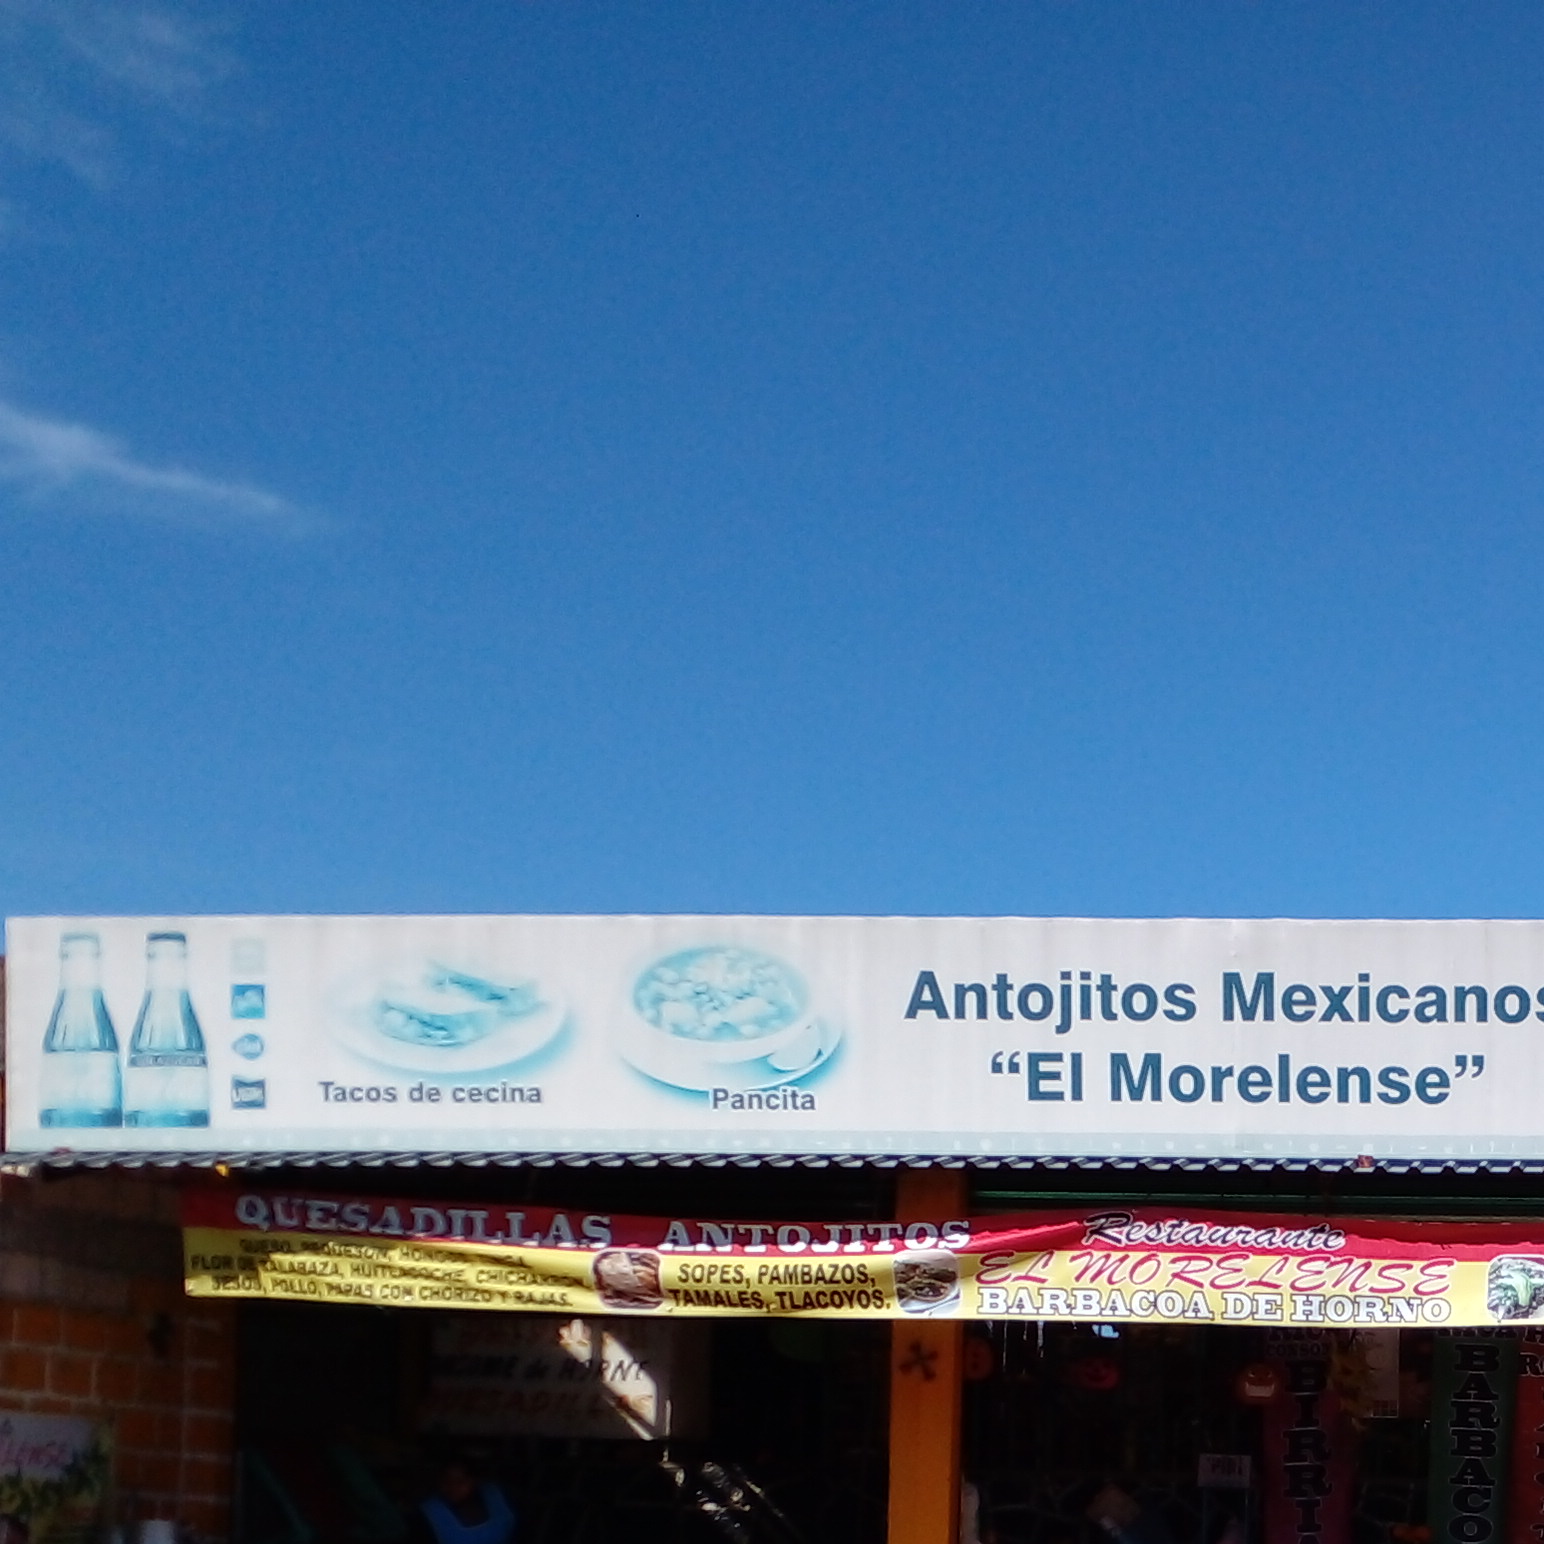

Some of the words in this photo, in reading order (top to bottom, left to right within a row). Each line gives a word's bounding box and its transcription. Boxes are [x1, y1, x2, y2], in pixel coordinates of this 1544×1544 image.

[904, 971, 1197, 1033] Antojitos
[319, 1081, 398, 1102] Tacos
[409, 1081, 441, 1102] de
[452, 1081, 543, 1104] cecina
[990, 1051, 1084, 1102] “El
[1109, 1052, 1486, 1105] Morelense”
[711, 1087, 817, 1111] Pancita
[233, 1194, 612, 1248] QUESADILLAS
[656, 1219, 971, 1253] ANTOJITOS
[1081, 1209, 1347, 1250] Restaurante
[677, 1263, 751, 1289] SOPES,
[757, 1262, 876, 1289] PAMBAZOS,
[975, 1249, 1054, 1285] EL
[1068, 1250, 1457, 1297] MORELENSE
[418, 1285, 493, 1302] CHORIZO
[669, 1288, 772, 1312] TAMALES,
[775, 1287, 892, 1311] TLACOYOS.
[976, 1286, 1215, 1321] BARBACOA
[1221, 1290, 1285, 1324] DE
[1290, 1292, 1453, 1324] HORNO
